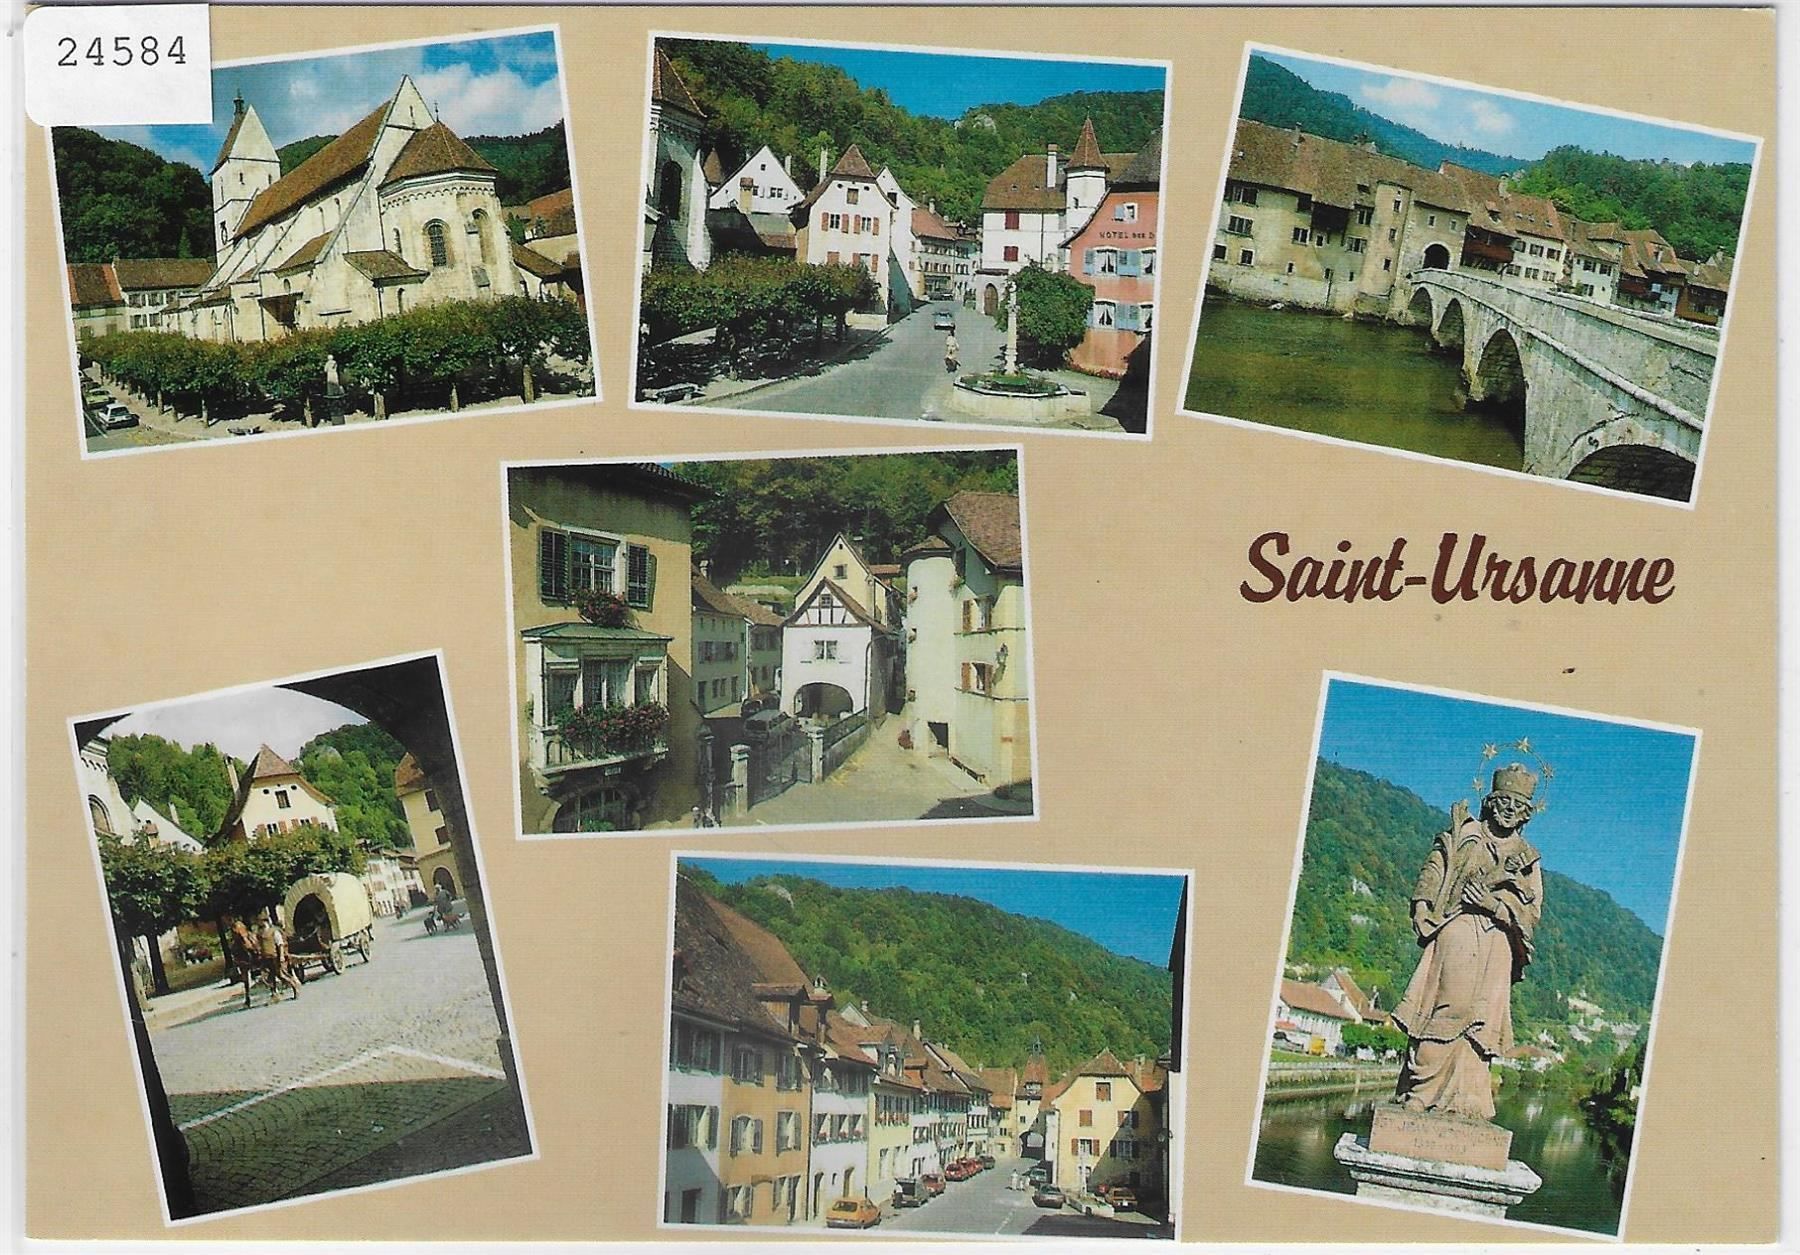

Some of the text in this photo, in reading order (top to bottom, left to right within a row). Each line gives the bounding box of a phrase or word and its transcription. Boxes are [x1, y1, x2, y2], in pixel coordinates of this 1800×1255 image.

[57, 35, 187, 67] 24584
[1099, 231, 1129, 239] HOTEL
[1240, 531, 1676, 605] Saint-Ursanne
